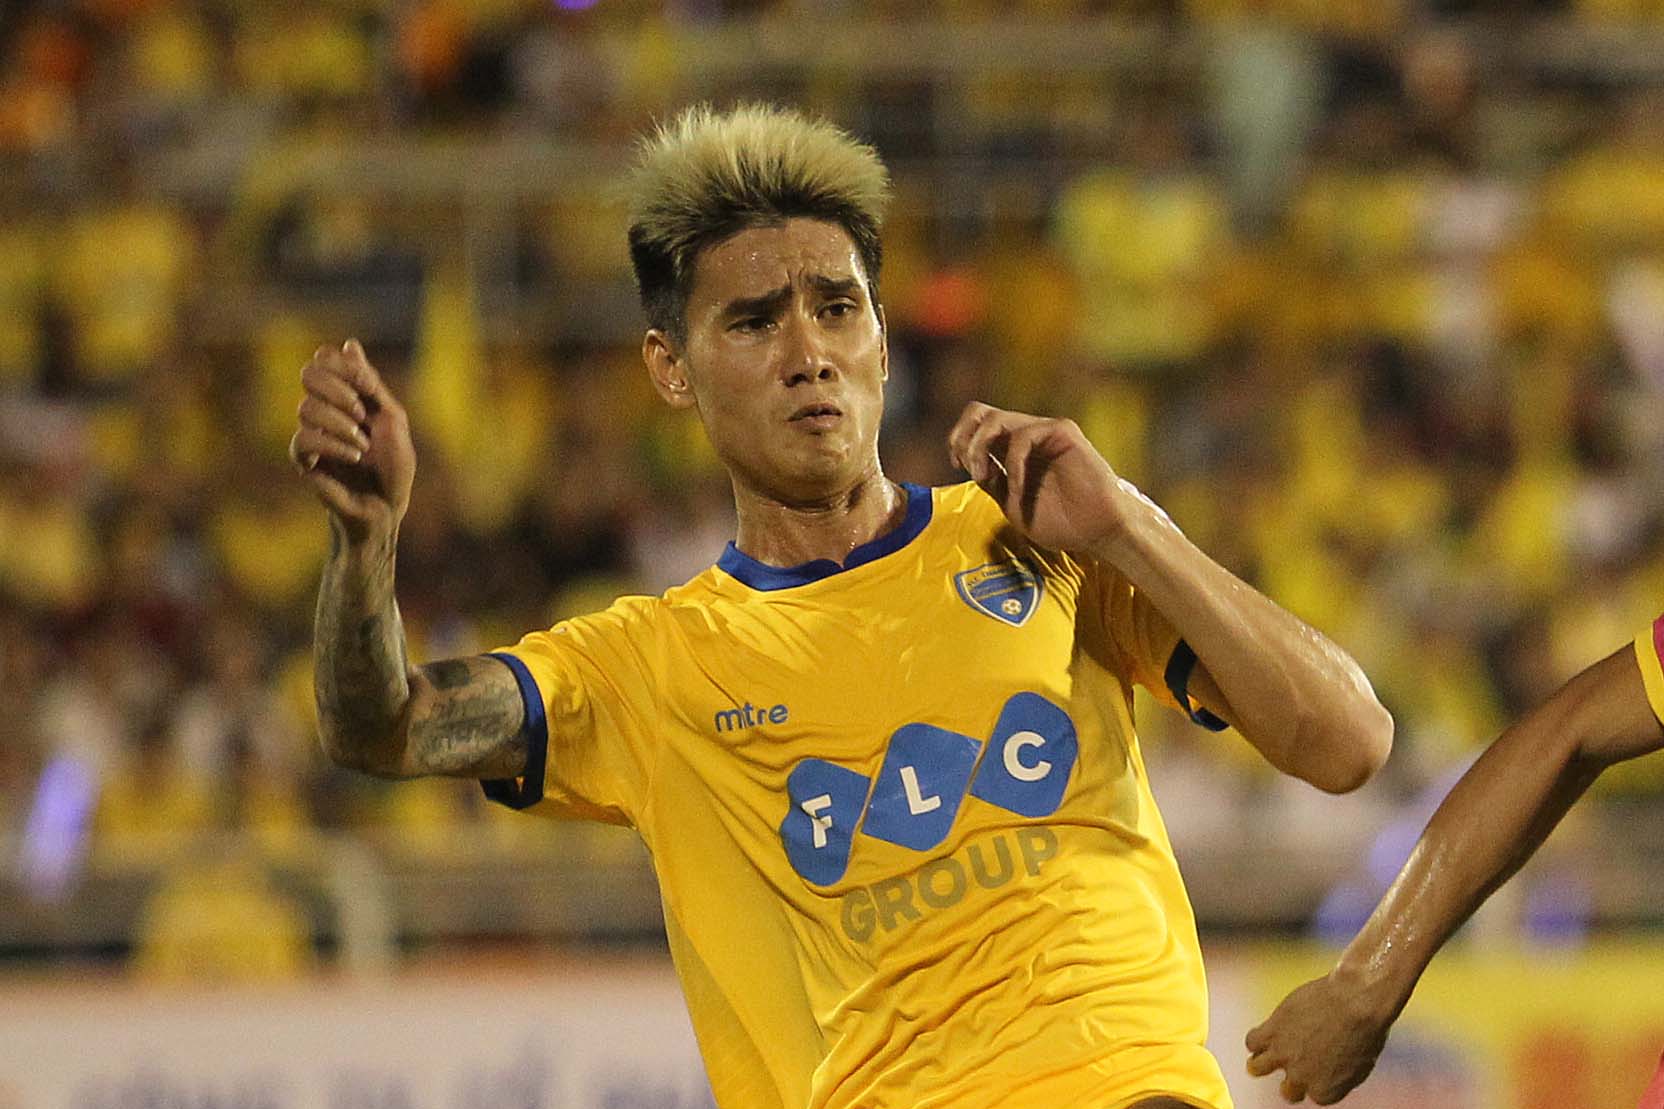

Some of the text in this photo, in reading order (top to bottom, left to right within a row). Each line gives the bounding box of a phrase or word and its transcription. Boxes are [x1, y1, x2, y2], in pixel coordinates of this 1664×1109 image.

[714, 702, 789, 732] mtre
[801, 730, 1053, 849] FLC
[840, 825, 1059, 944] GROUP
